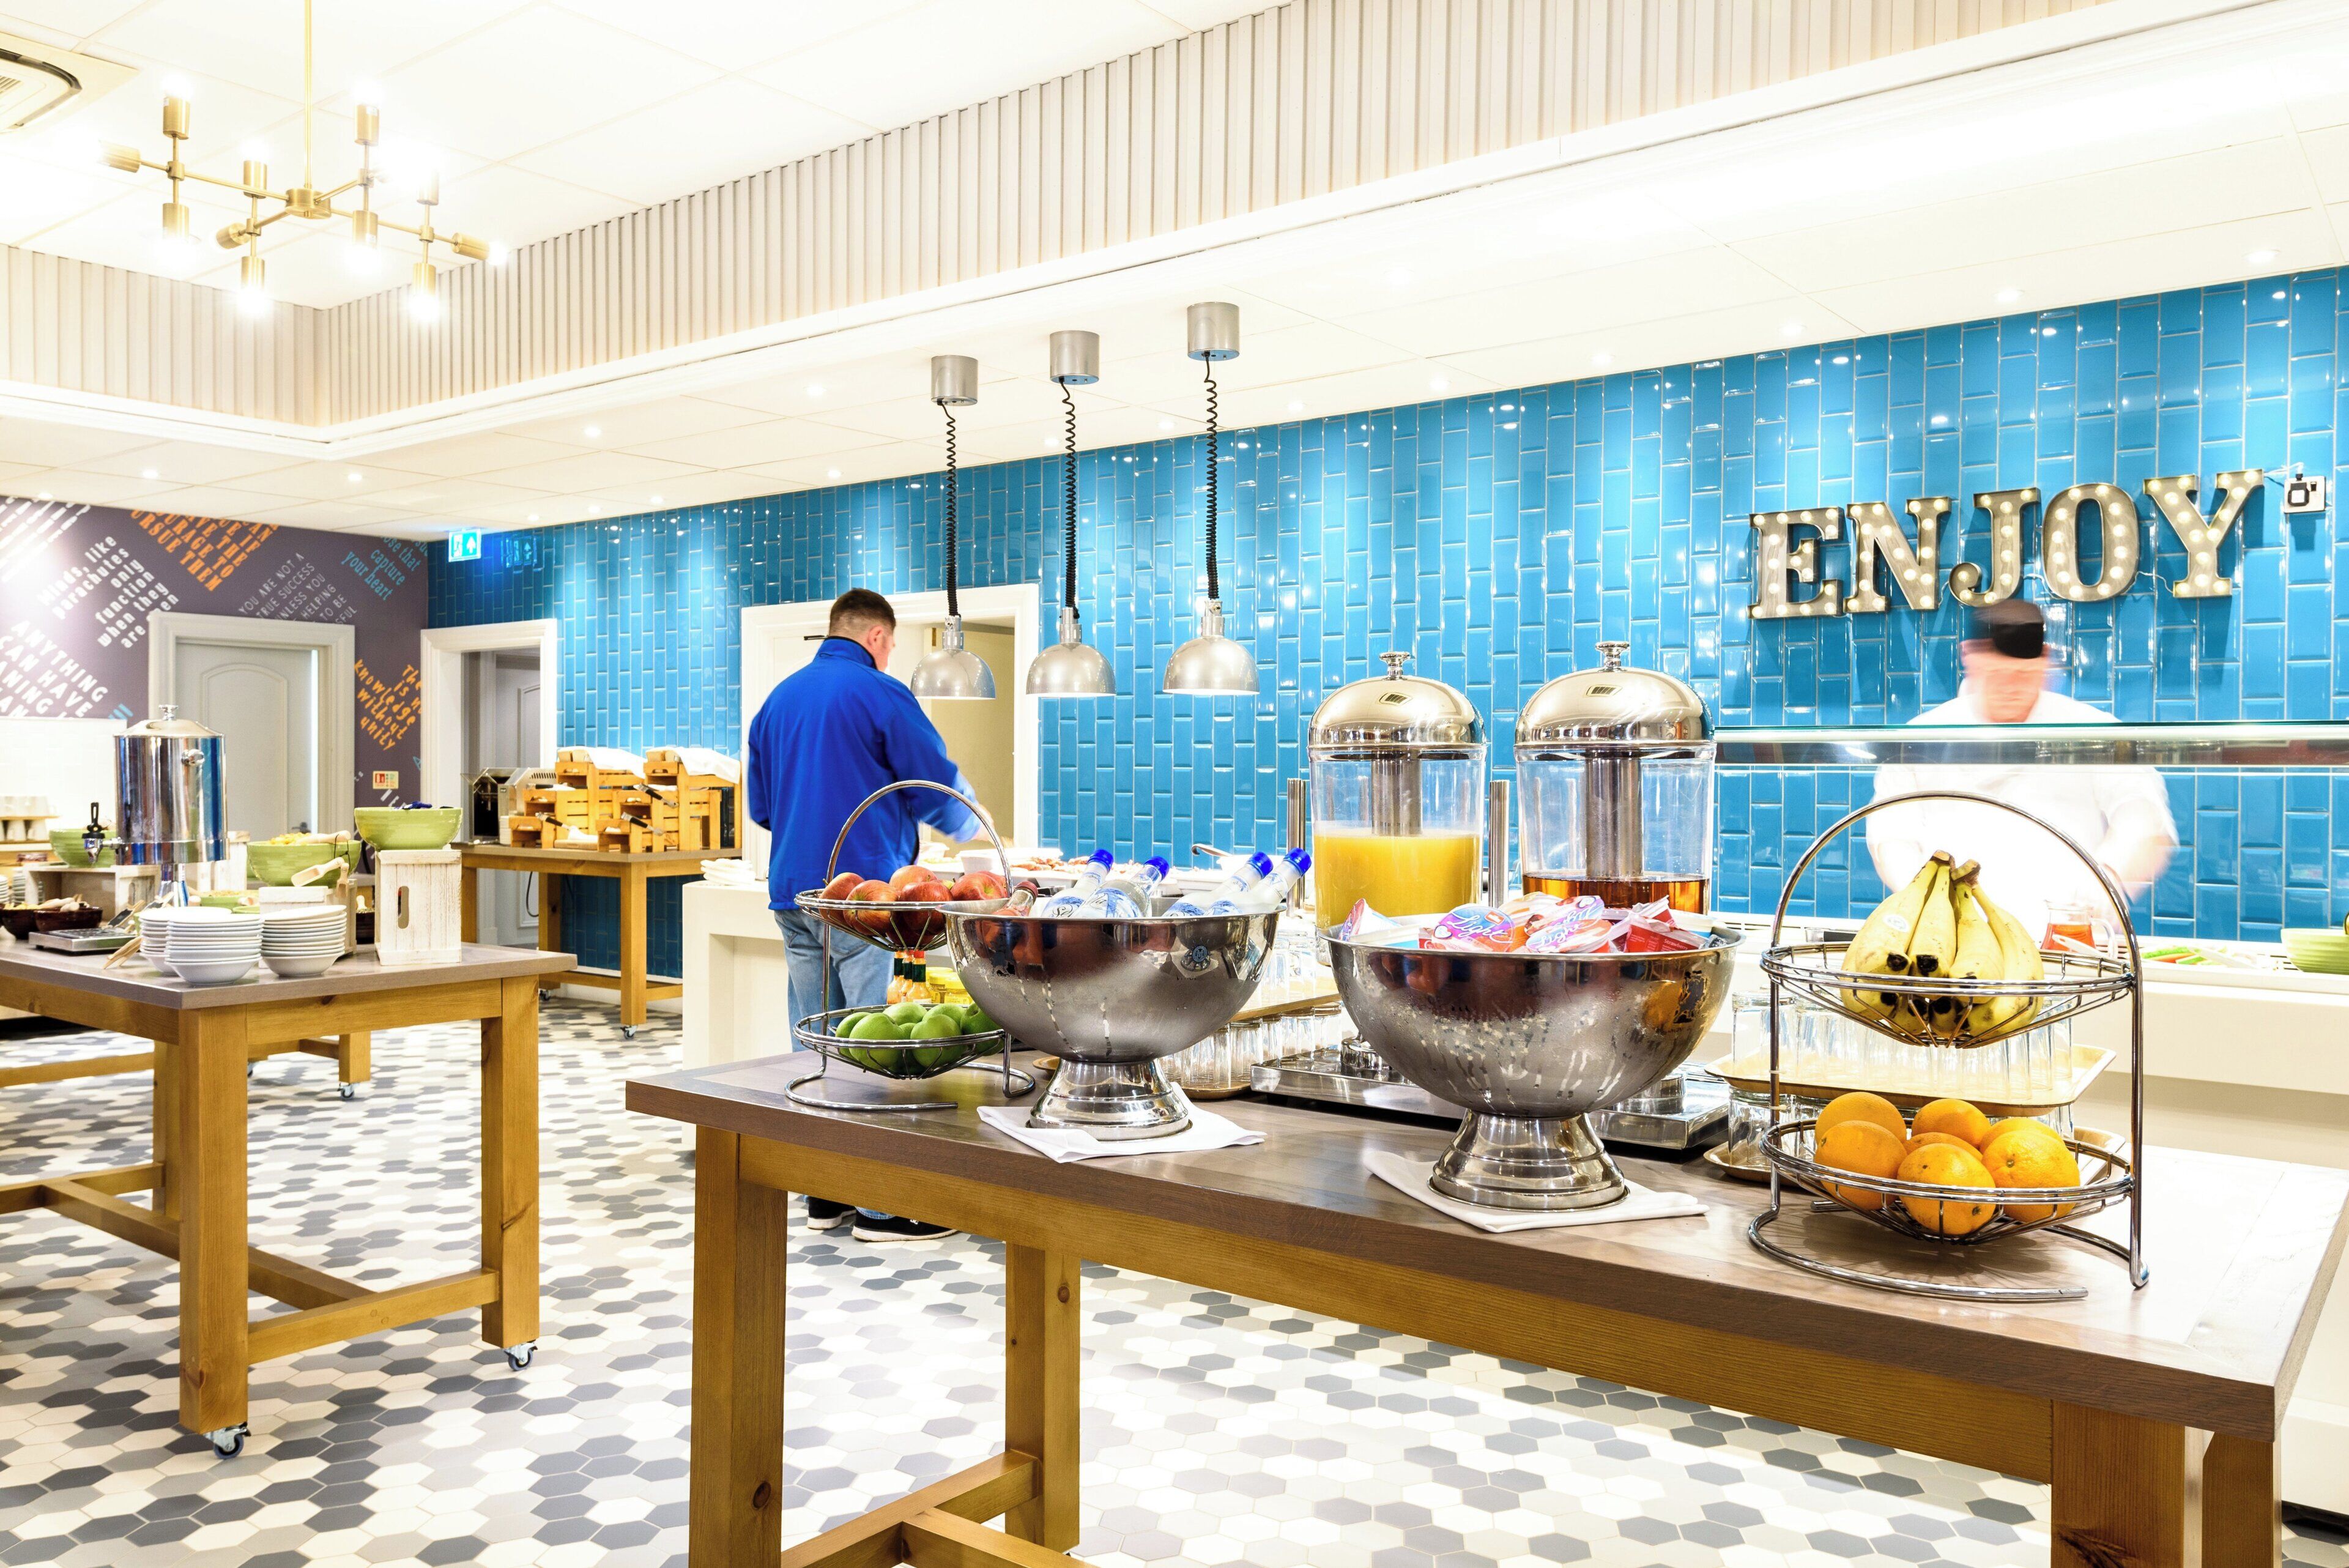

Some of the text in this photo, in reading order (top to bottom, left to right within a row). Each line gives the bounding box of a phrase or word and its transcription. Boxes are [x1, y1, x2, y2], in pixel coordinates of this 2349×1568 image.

[84, 536, 117, 563] like
[216, 535, 248, 567] THE
[239, 534, 261, 552] IF
[399, 548, 421, 571] that
[1748, 469, 2263, 620] ENJOY
[52, 548, 129, 620] parachutes
[111, 559, 144, 588] only
[180, 551, 223, 591] THEM
[212, 555, 234, 578] TO
[238, 552, 305, 614] YOU ARE NOT A
[278, 563, 314, 599] SUCCESS
[306, 573, 325, 591] YOU
[341, 551, 393, 601] your heart
[371, 549, 406, 585] capture
[95, 571, 154, 624] function
[97, 582, 169, 647] when they
[301, 584, 336, 619] HELPING
[319, 594, 347, 620] TO BE
[121, 625, 146, 648] are
[0, 636, 93, 718] CAN HAVE
[11, 620, 108, 702] ANYTHING
[354, 659, 416, 726] knowledge
[394, 680, 409, 696] is
[357, 688, 408, 740] without
[360, 716, 396, 751] unity
[1447, 911, 1513, 943] Light
[1663, 938, 1688, 950] Strawberry
